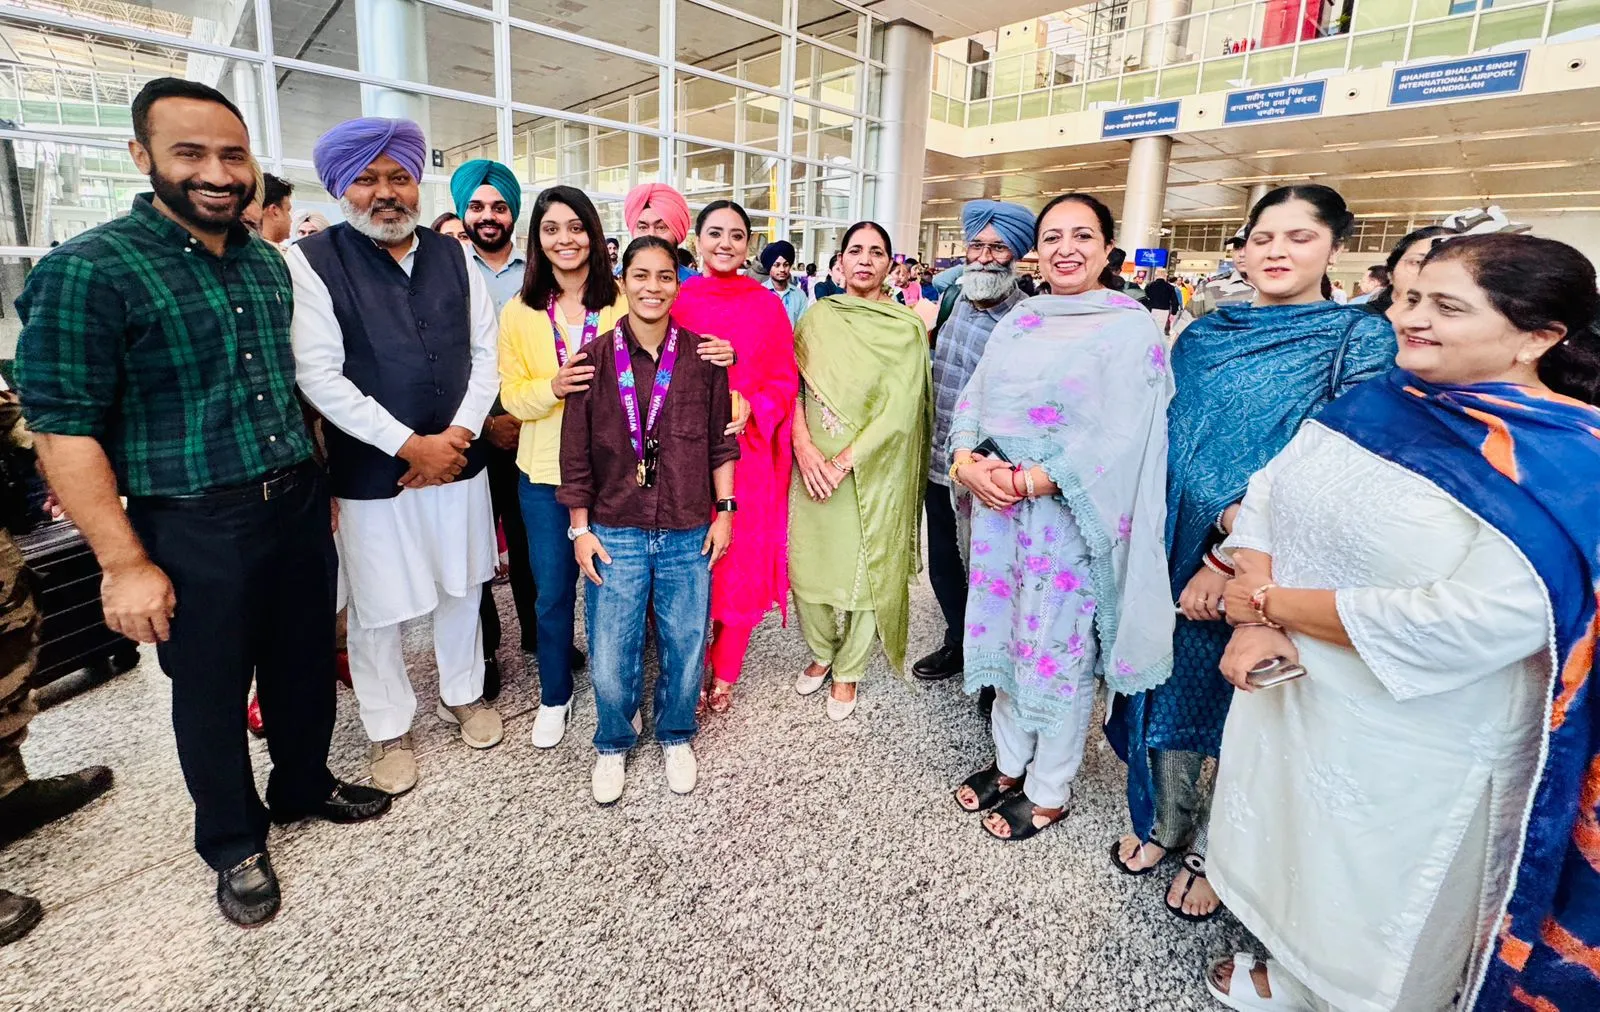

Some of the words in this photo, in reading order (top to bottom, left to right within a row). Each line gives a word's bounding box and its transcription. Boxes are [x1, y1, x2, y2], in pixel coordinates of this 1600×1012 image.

[1398, 76, 1469, 90] INTERNATIONAL
[1471, 69, 1516, 80] AIRPORT,
[1400, 69, 1443, 82] SHAHEED
[1444, 65, 1483, 76] BHAGAT
[1485, 60, 1517, 71] SINGH
[1422, 81, 1485, 95] CHANDIGARH
[624, 393, 638, 432] WINNER
[646, 395, 663, 431] WINNER
